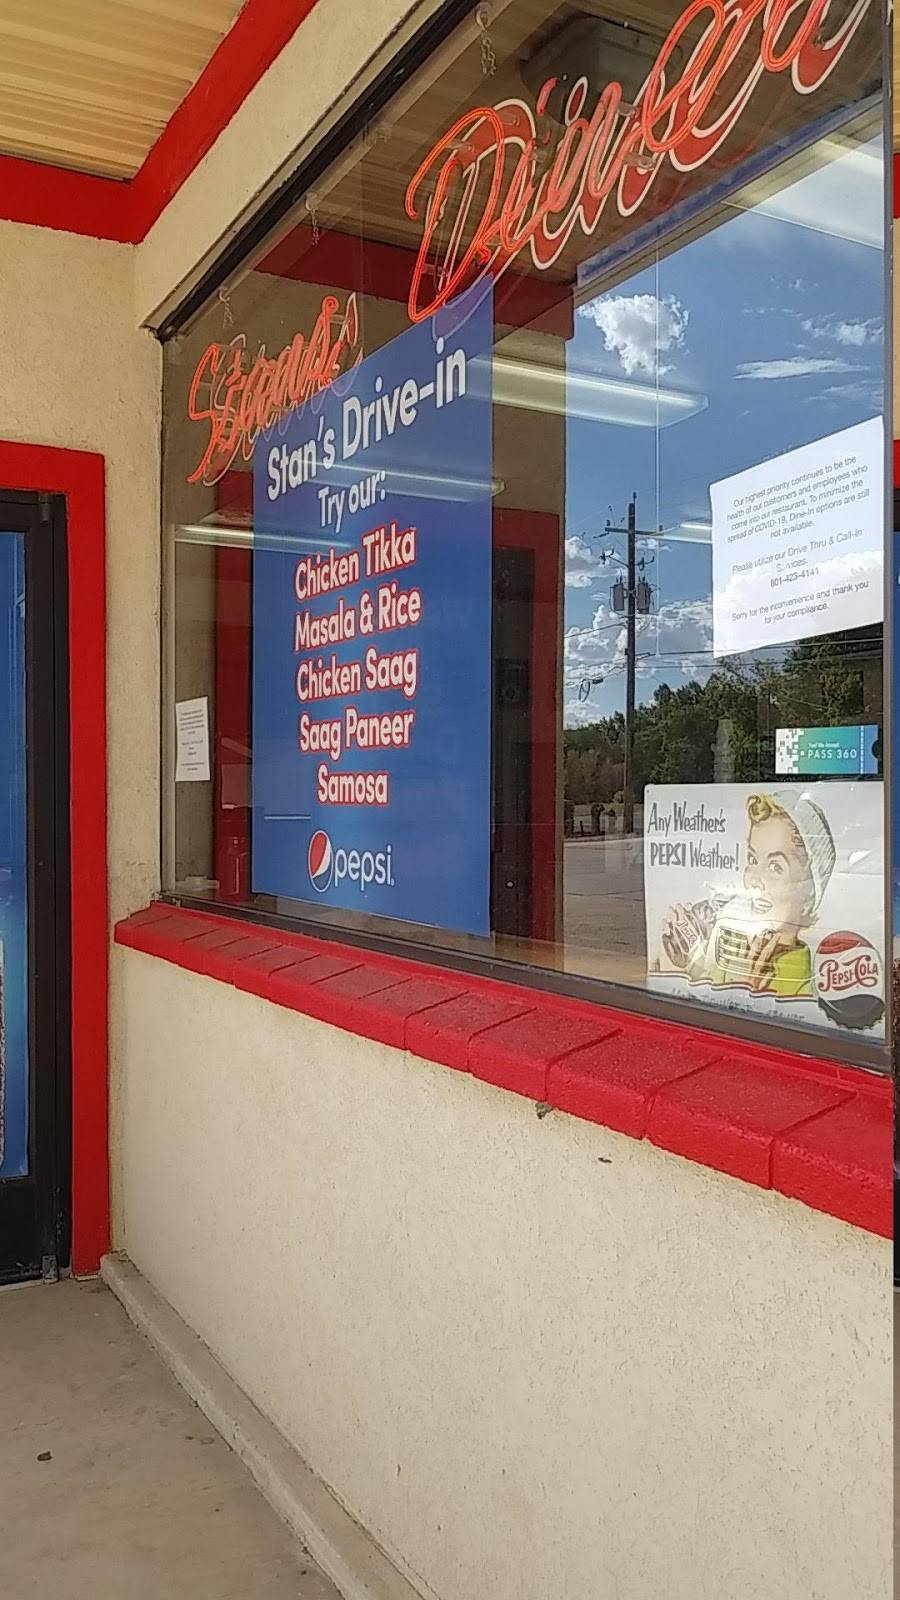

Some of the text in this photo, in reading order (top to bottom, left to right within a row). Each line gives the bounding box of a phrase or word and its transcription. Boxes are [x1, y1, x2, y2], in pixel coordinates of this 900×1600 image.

[267, 336, 467, 501] Stan's Drive-in
[318, 469, 387, 534] Try our:
[727, 465, 868, 521] health of our customers and employees who
[731, 520, 748, 530] come
[749, 514, 760, 524] into
[761, 512, 770, 520] our
[809, 494, 817, 503] To
[819, 483, 849, 500] minimize
[852, 479, 863, 489] the
[734, 456, 856, 507] Our highest priority continues to be the
[728, 531, 746, 543] spread
[748, 526, 754, 535] of
[816, 498, 842, 514] options
[844, 494, 855, 504] are
[858, 488, 870, 499] still
[770, 528, 781, 538] not
[295, 522, 416, 600] Chicken Tikka
[732, 561, 753, 574] Please
[755, 555, 773, 567] utilize
[775, 552, 786, 561] our
[788, 544, 807, 556] Drive
[810, 540, 826, 550] Thru
[828, 536, 834, 545] &
[295, 583, 421, 651] Masala & Rice
[732, 580, 869, 621] Sorry for the inconvenience and thank you
[764, 615, 772, 624] for
[772, 612, 786, 624] your
[297, 647, 417, 701] Chicken Saag
[300, 708, 414, 760] Saag Paneer
[807, 748, 857, 759] PASS 360
[317, 764, 388, 803] Samosa
[647, 801, 726, 837] Any Weather's
[334, 845, 393, 892] pepsi
[650, 840, 739, 871] PEPSI Weather!
